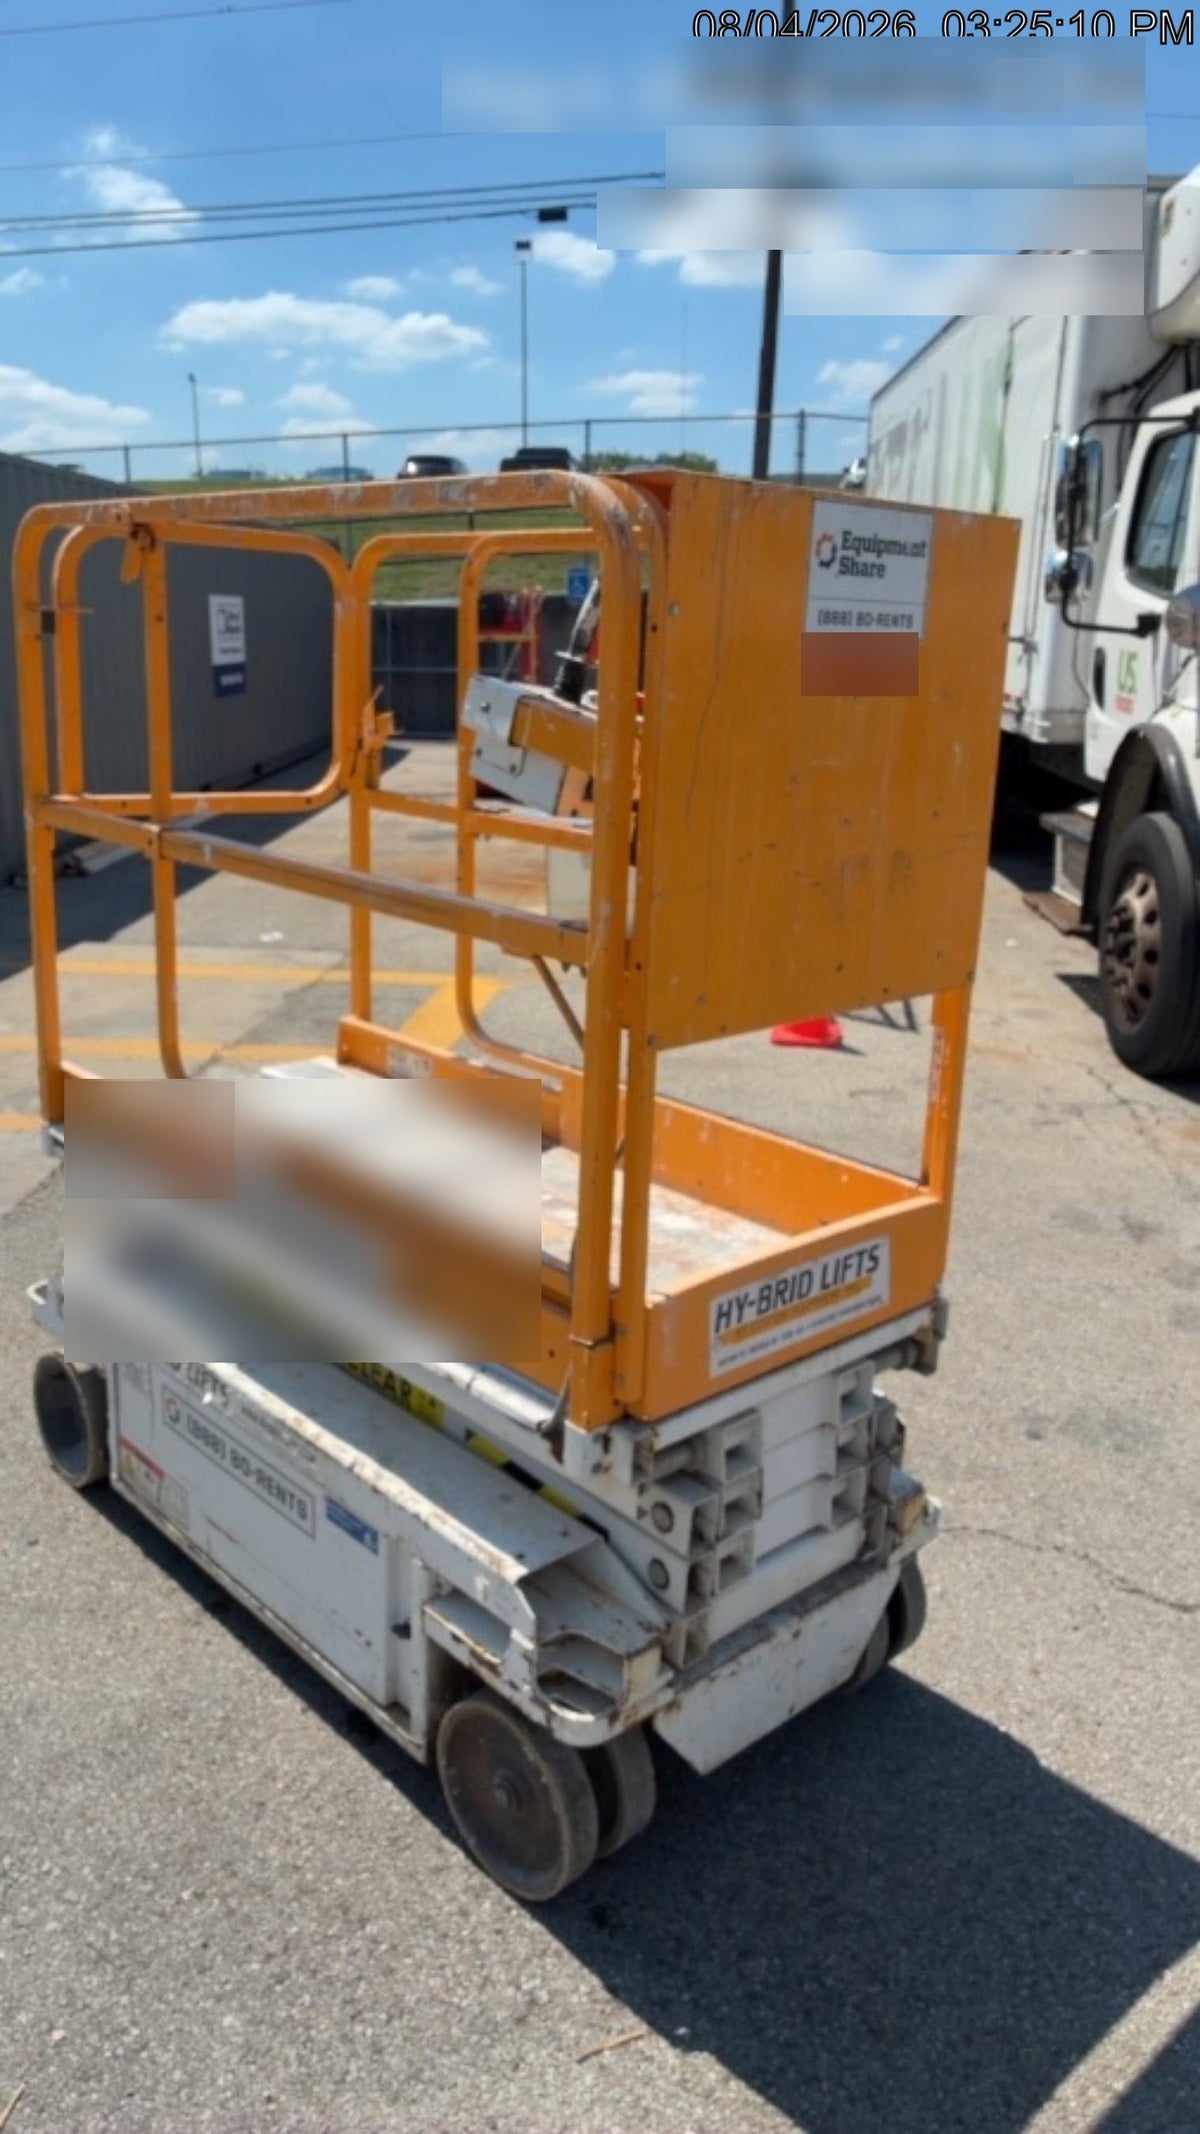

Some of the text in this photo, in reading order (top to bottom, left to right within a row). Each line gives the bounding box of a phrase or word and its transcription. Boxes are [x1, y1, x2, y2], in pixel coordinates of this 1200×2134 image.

[838, 556, 886, 579] Share
[817, 608, 853, 626] (888)
[715, 1269, 814, 1334] HY-BRID
[819, 1243, 882, 1291] LIFTS
